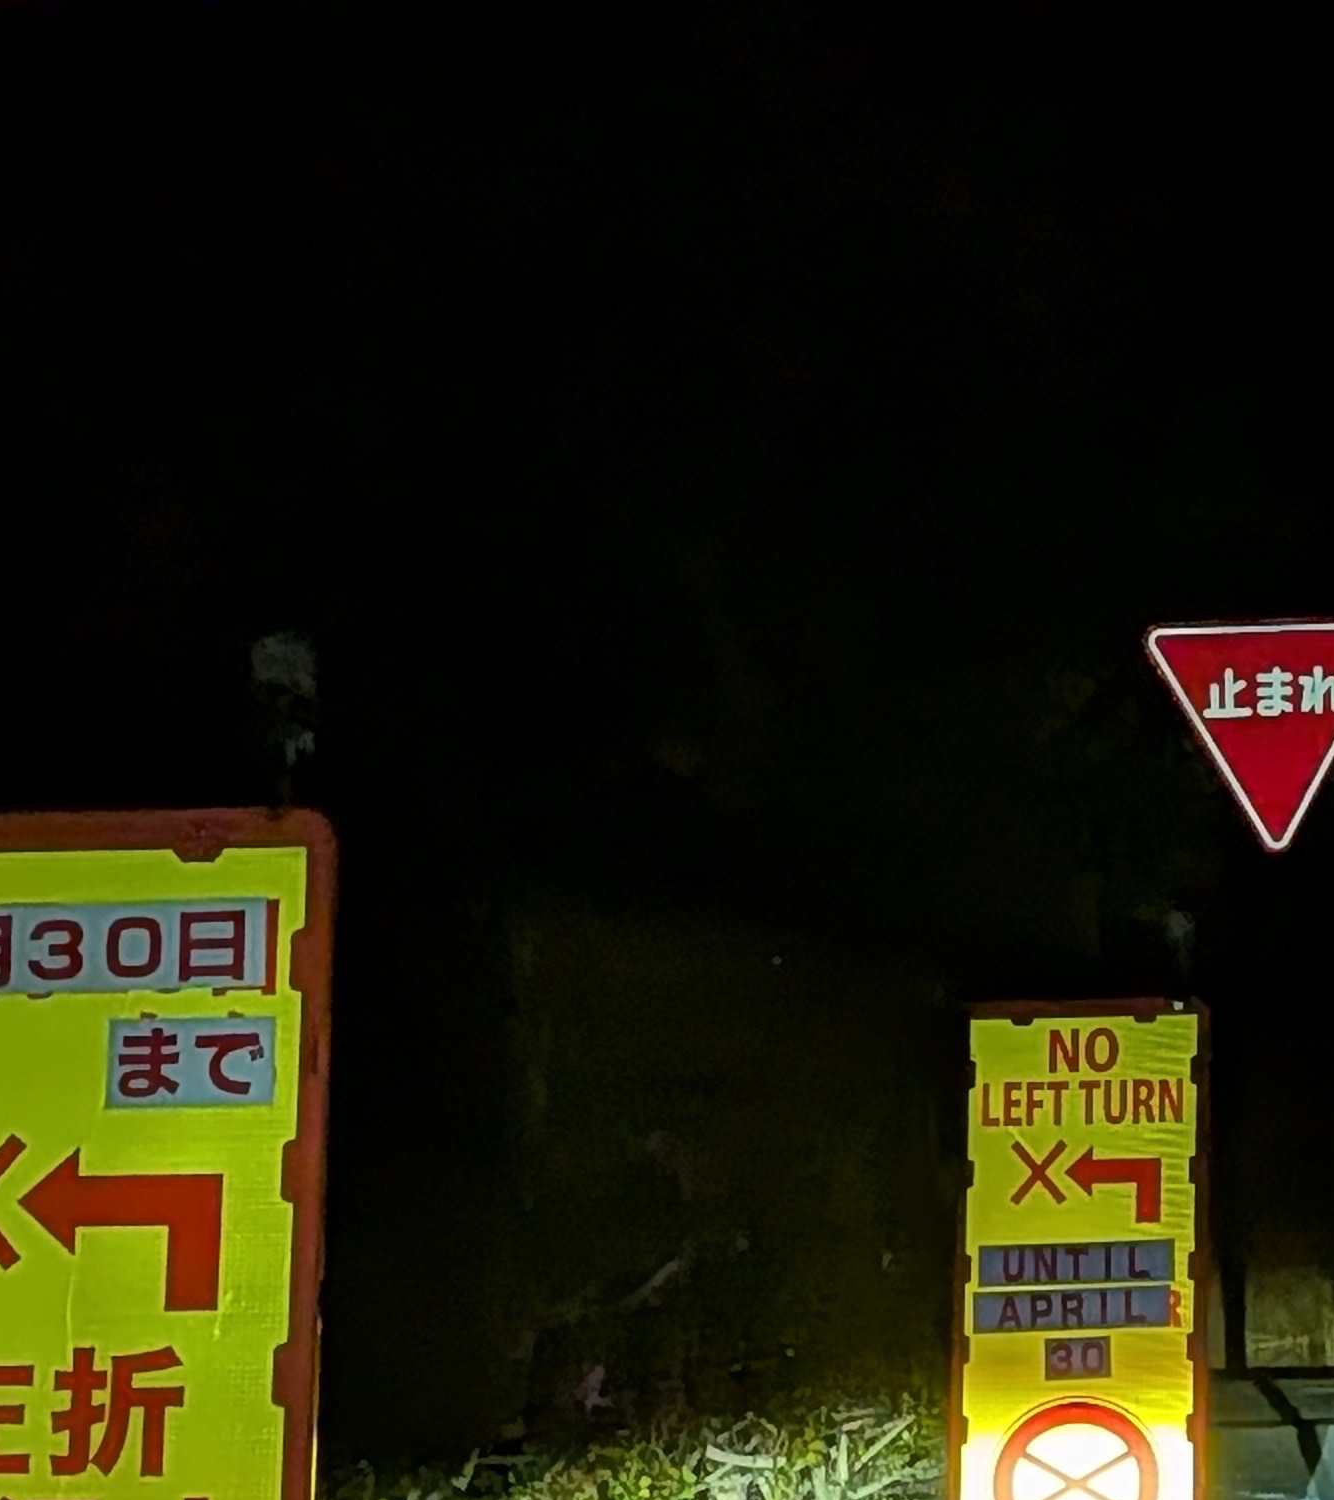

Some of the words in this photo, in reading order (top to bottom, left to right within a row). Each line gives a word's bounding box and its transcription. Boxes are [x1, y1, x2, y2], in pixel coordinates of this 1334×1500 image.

[117, 1027, 266, 1098] まで
[1048, 1027, 1119, 1073] NO
[981, 1080, 1071, 1128] LEFT
[1078, 1077, 1184, 1125] TURN
[1002, 1244, 1152, 1283] UNTIL
[998, 1290, 1148, 1330] APRIL
[1050, 1341, 1105, 1377] 30
